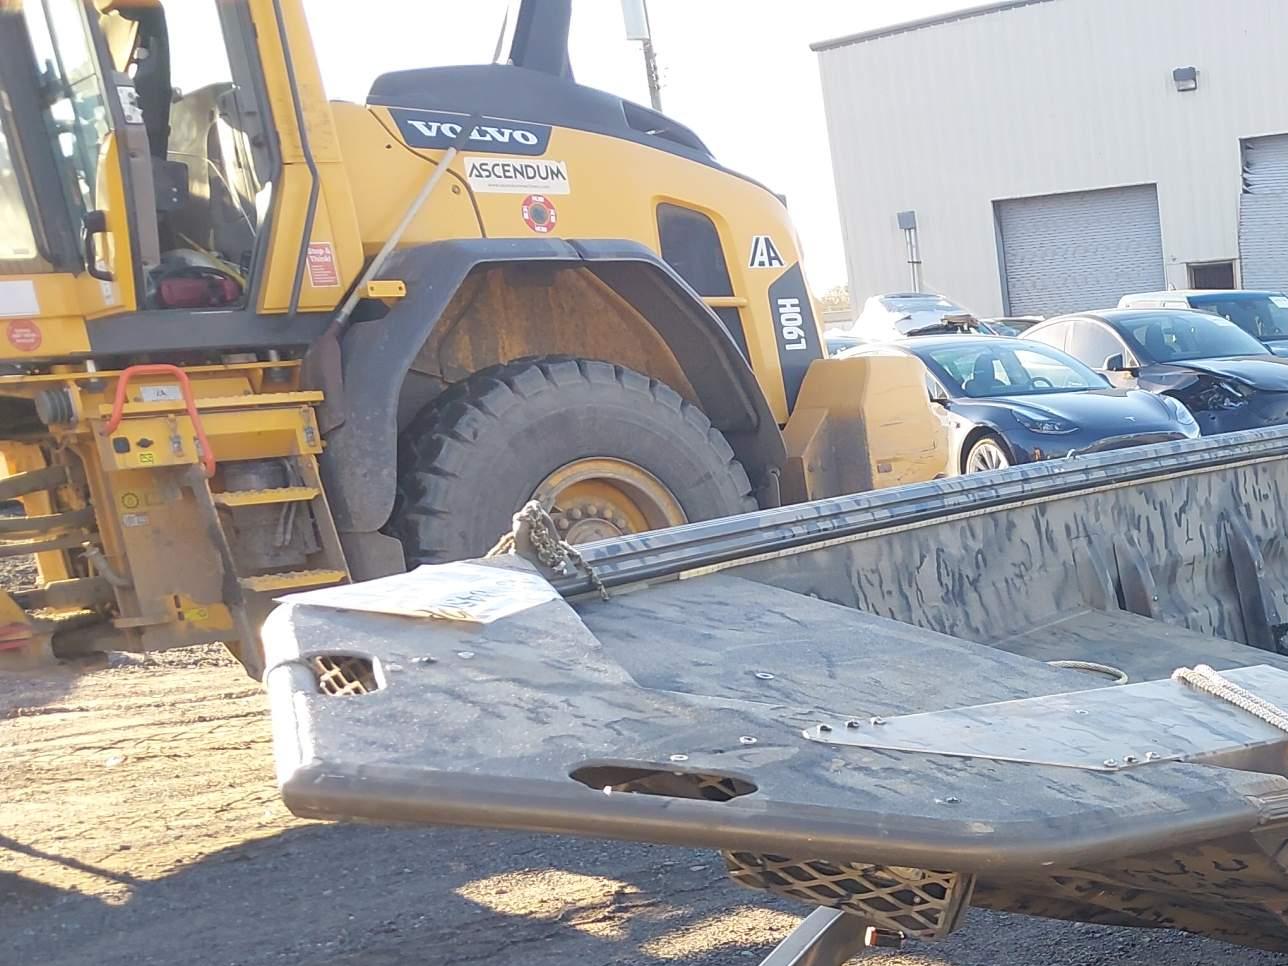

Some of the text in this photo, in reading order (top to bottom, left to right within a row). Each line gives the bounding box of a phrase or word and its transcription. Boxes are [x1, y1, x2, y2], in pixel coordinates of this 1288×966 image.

[407, 120, 538, 145] VOLVO
[468, 162, 567, 181] ASCENDUM
[777, 298, 807, 351] L90H
